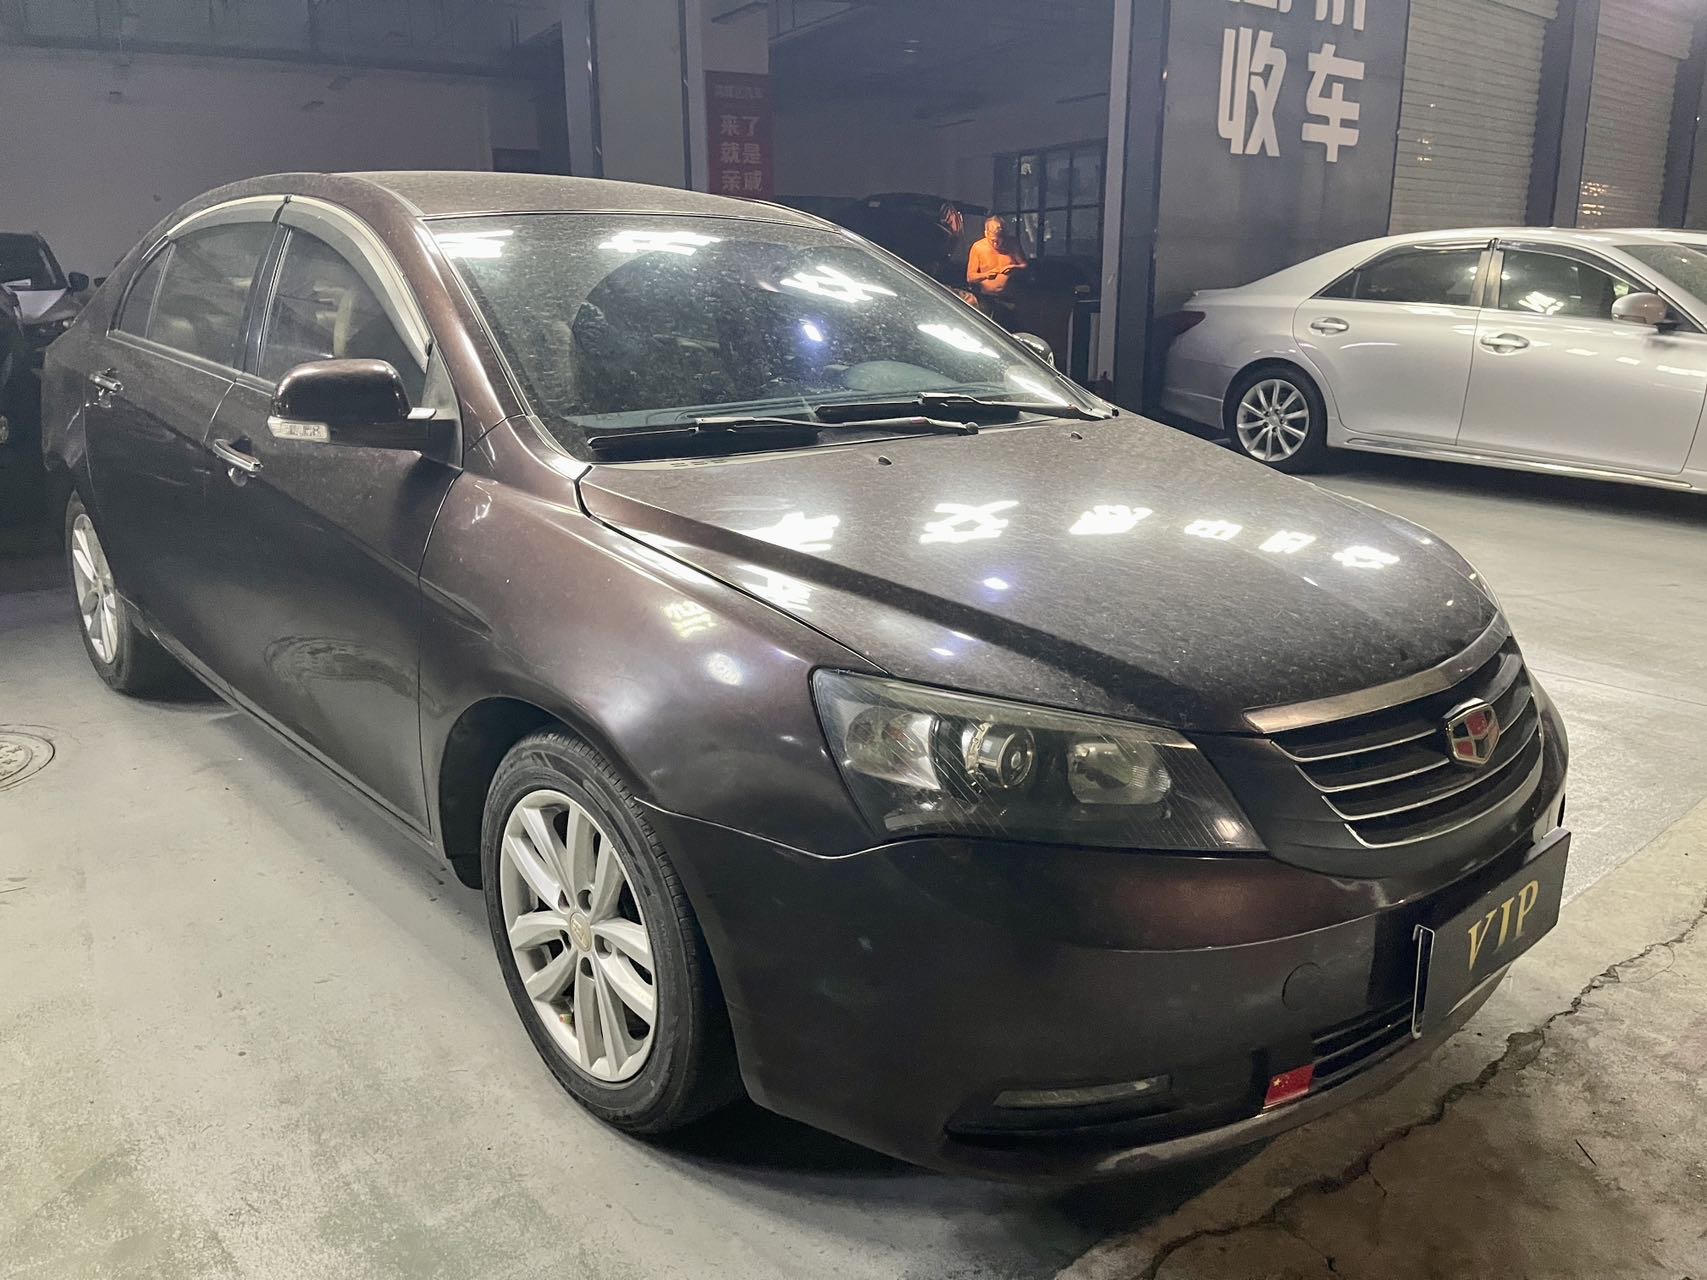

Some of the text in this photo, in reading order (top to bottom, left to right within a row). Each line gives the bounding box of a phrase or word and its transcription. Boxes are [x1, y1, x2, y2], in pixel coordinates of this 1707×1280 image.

[1218, 26, 1366, 163] 收车
[720, 114, 760, 136] 来了
[720, 142, 762, 164] 就是
[1467, 880, 1540, 971] VIP
